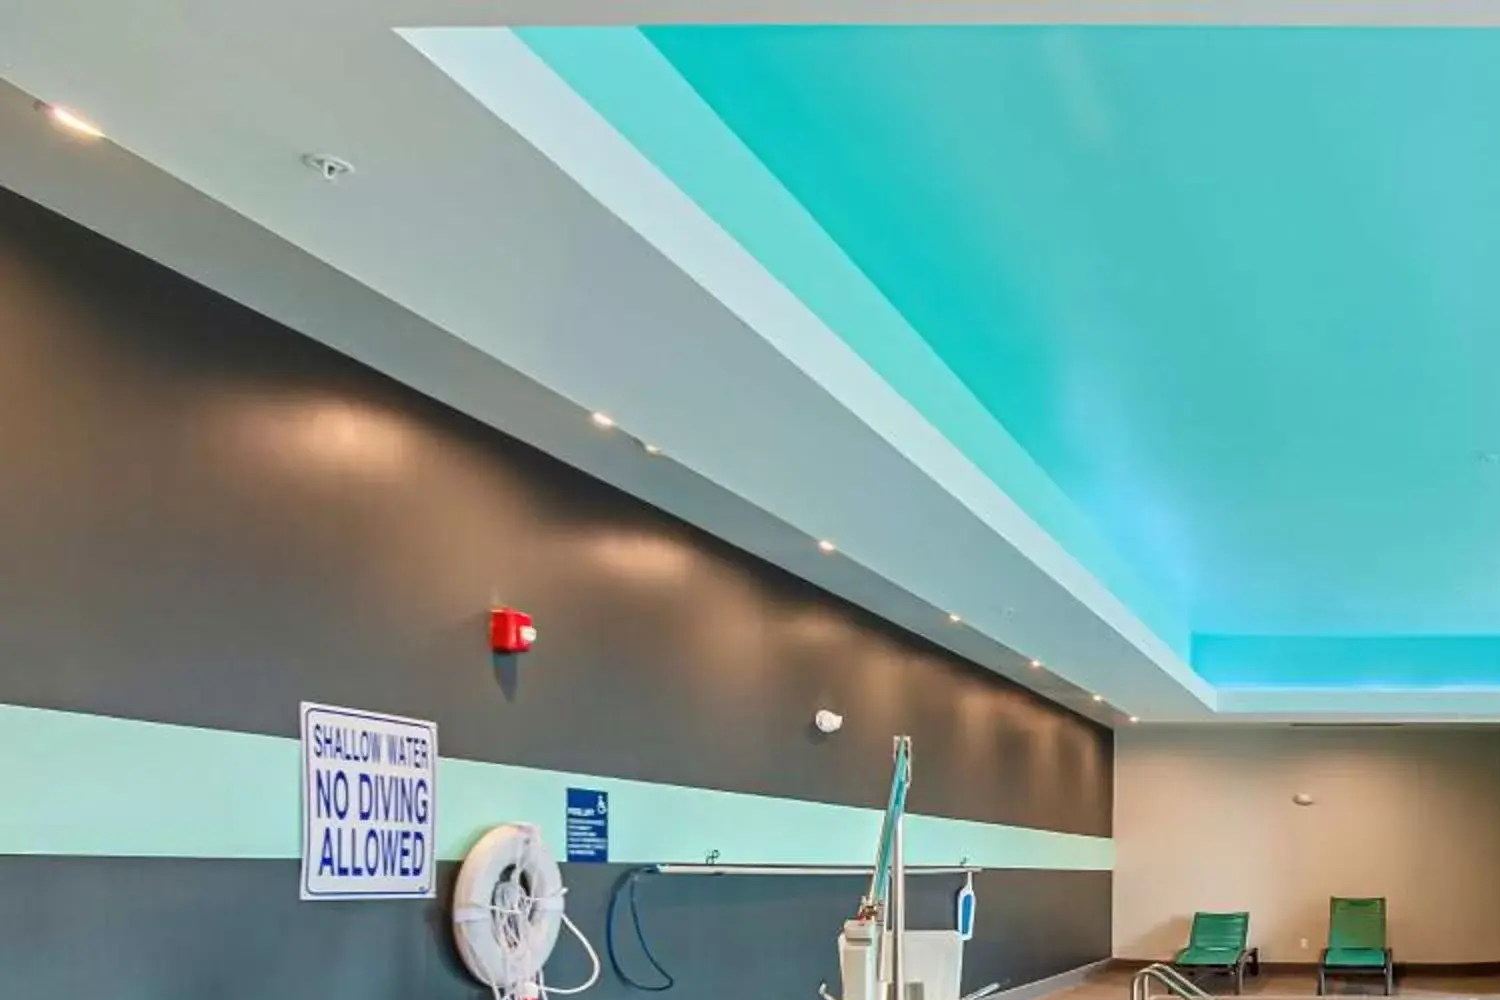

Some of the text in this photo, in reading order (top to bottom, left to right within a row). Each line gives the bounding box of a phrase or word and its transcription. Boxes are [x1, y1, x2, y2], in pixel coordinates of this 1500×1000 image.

[314, 723, 429, 769] SHALLOW WATER
[317, 769, 429, 824] NO DIVING
[318, 828, 425, 876] ALLOWED
